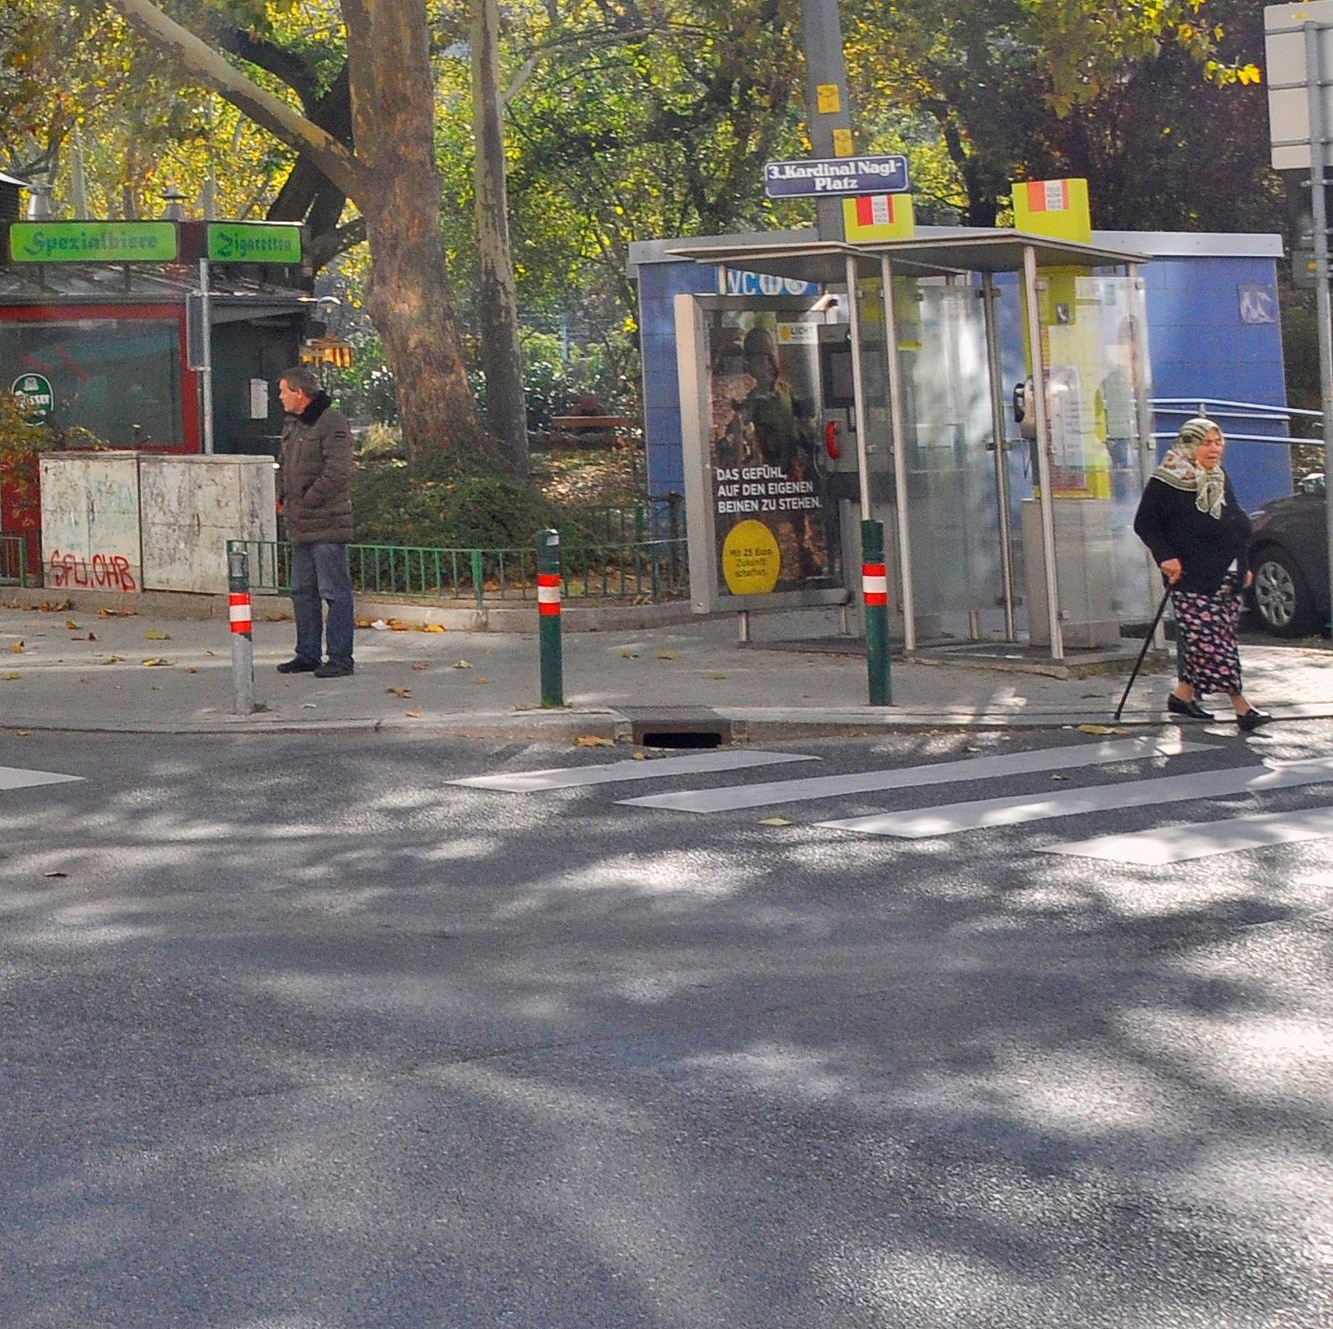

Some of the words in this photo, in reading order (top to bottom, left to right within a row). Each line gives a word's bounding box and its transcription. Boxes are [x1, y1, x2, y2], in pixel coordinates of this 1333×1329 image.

[784, 162, 856, 179] Kardinal
[858, 160, 902, 177] Nagl-
[815, 177, 859, 191] Platz
[717, 468, 739, 481] DAS
[742, 464, 787, 480] GEFÜHL,
[718, 484, 740, 497] AUF
[742, 483, 765, 496] DEN
[768, 480, 813, 495] EIGENEN
[718, 500, 759, 513] BEINEN
[761, 498, 776, 511] ZU
[779, 496, 822, 510] STEHEN.
